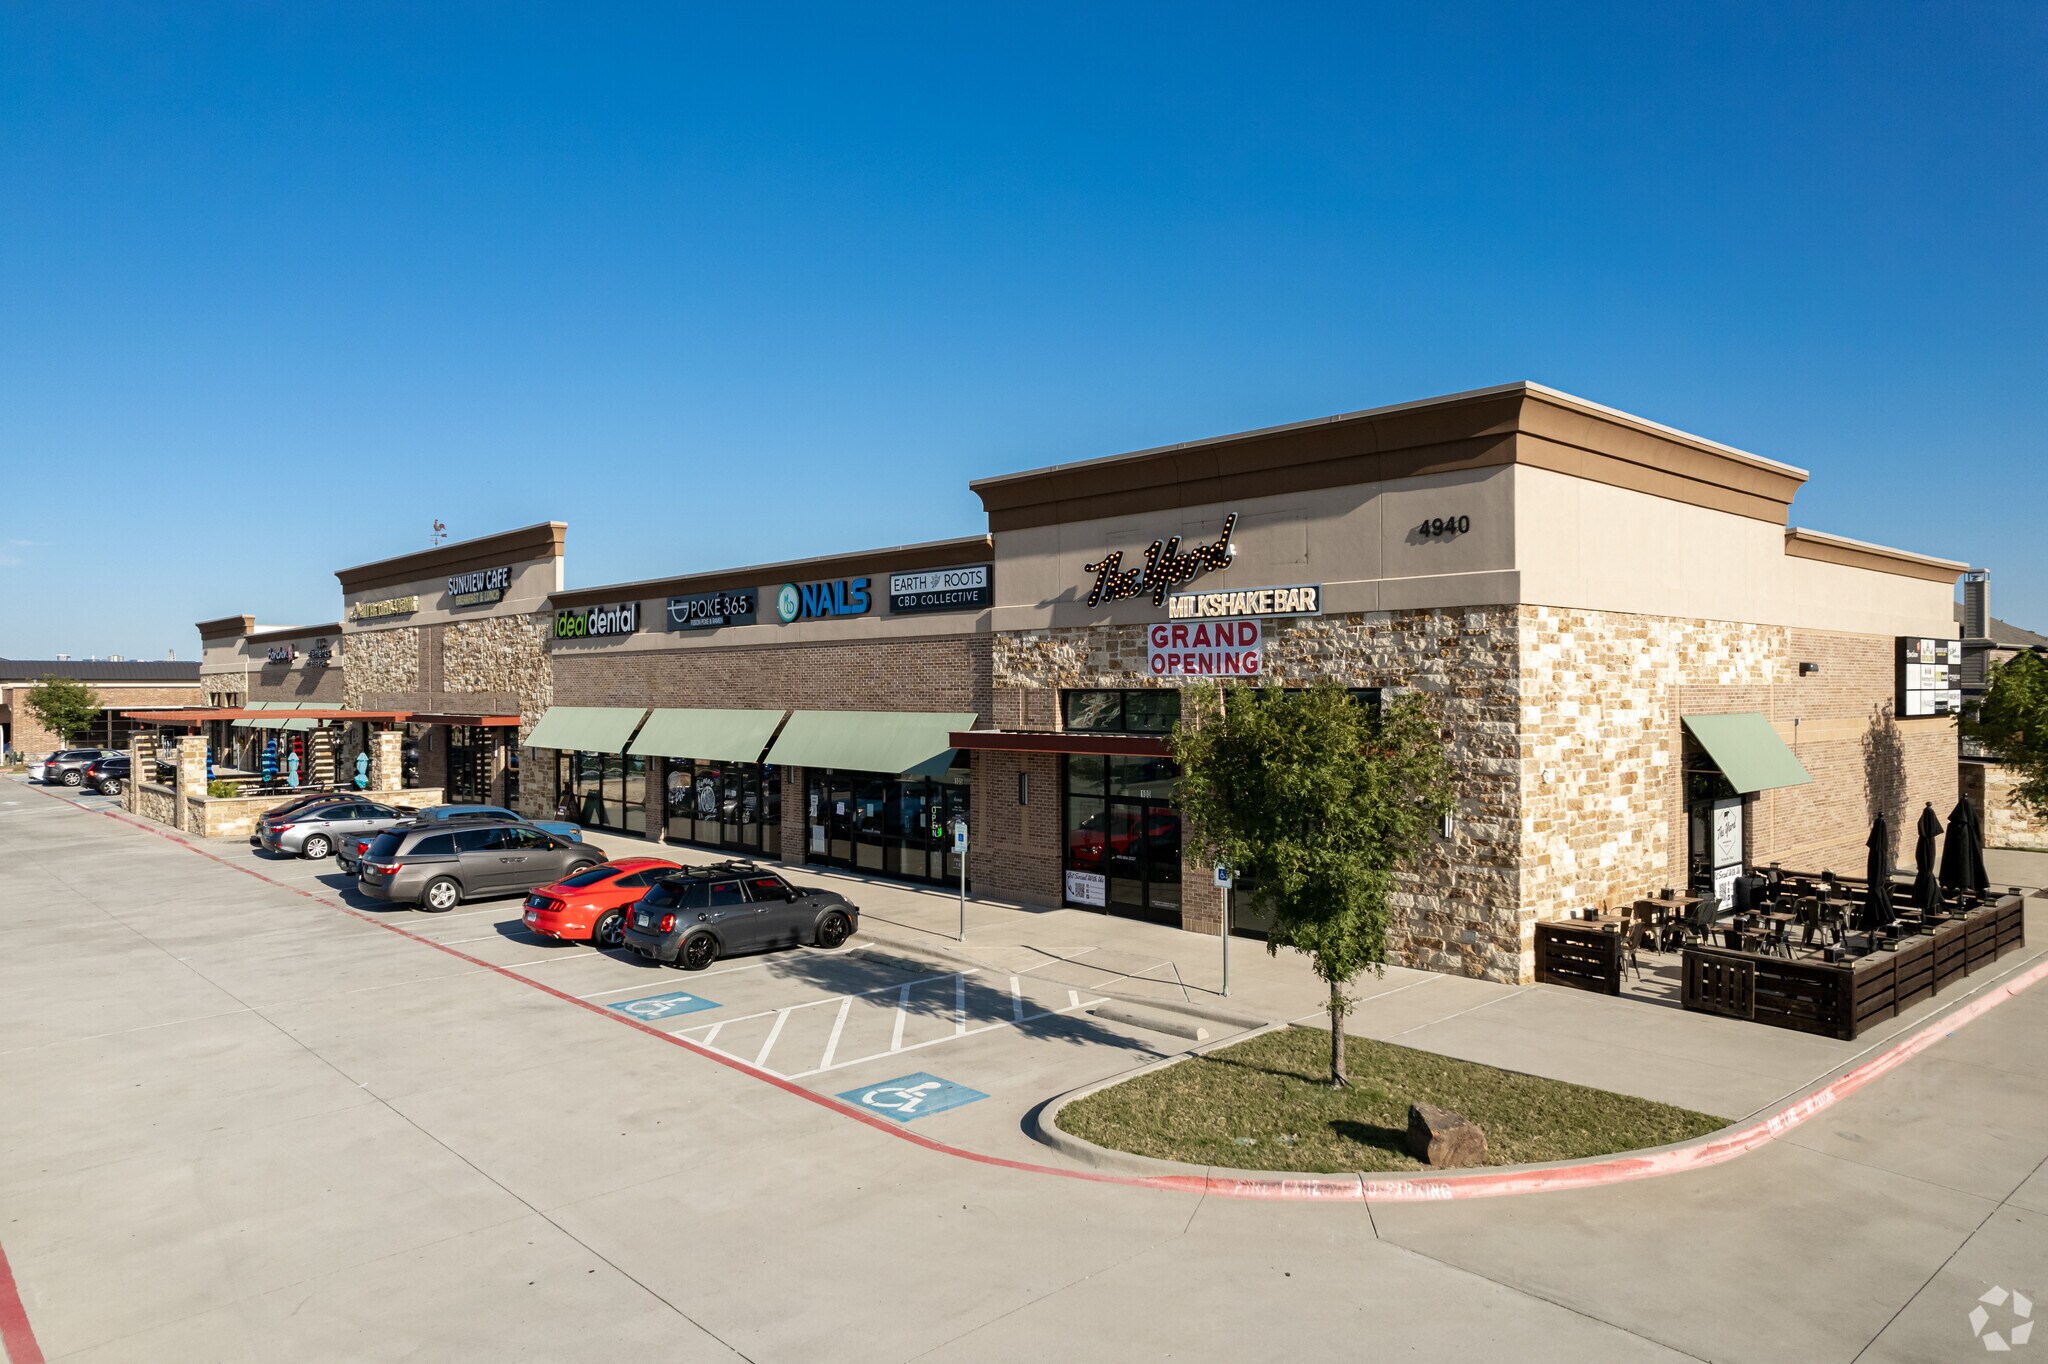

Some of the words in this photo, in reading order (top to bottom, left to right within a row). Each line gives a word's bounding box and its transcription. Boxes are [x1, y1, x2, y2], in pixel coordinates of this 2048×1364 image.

[1419, 515, 1470, 537] 4940
[1084, 551, 1142, 608] The
[1142, 512, 1238, 608] Yard
[448, 572, 485, 596] SUNVIEW
[486, 567, 509, 589] CAFE
[894, 576, 927, 592] EARTH
[944, 570, 983, 587] ROOTS
[723, 595, 747, 615] 365
[802, 578, 871, 617] NAILS
[897, 596, 917, 607] CBD
[920, 590, 979, 606] COLLECTIVE
[1169, 589, 1273, 619] MILKSHAKE
[1274, 587, 1317, 614] BAR
[554, 610, 588, 638] ideal
[588, 603, 637, 635] dental
[1151, 622, 1258, 649] GRAND
[1151, 651, 1258, 675] OPENING
